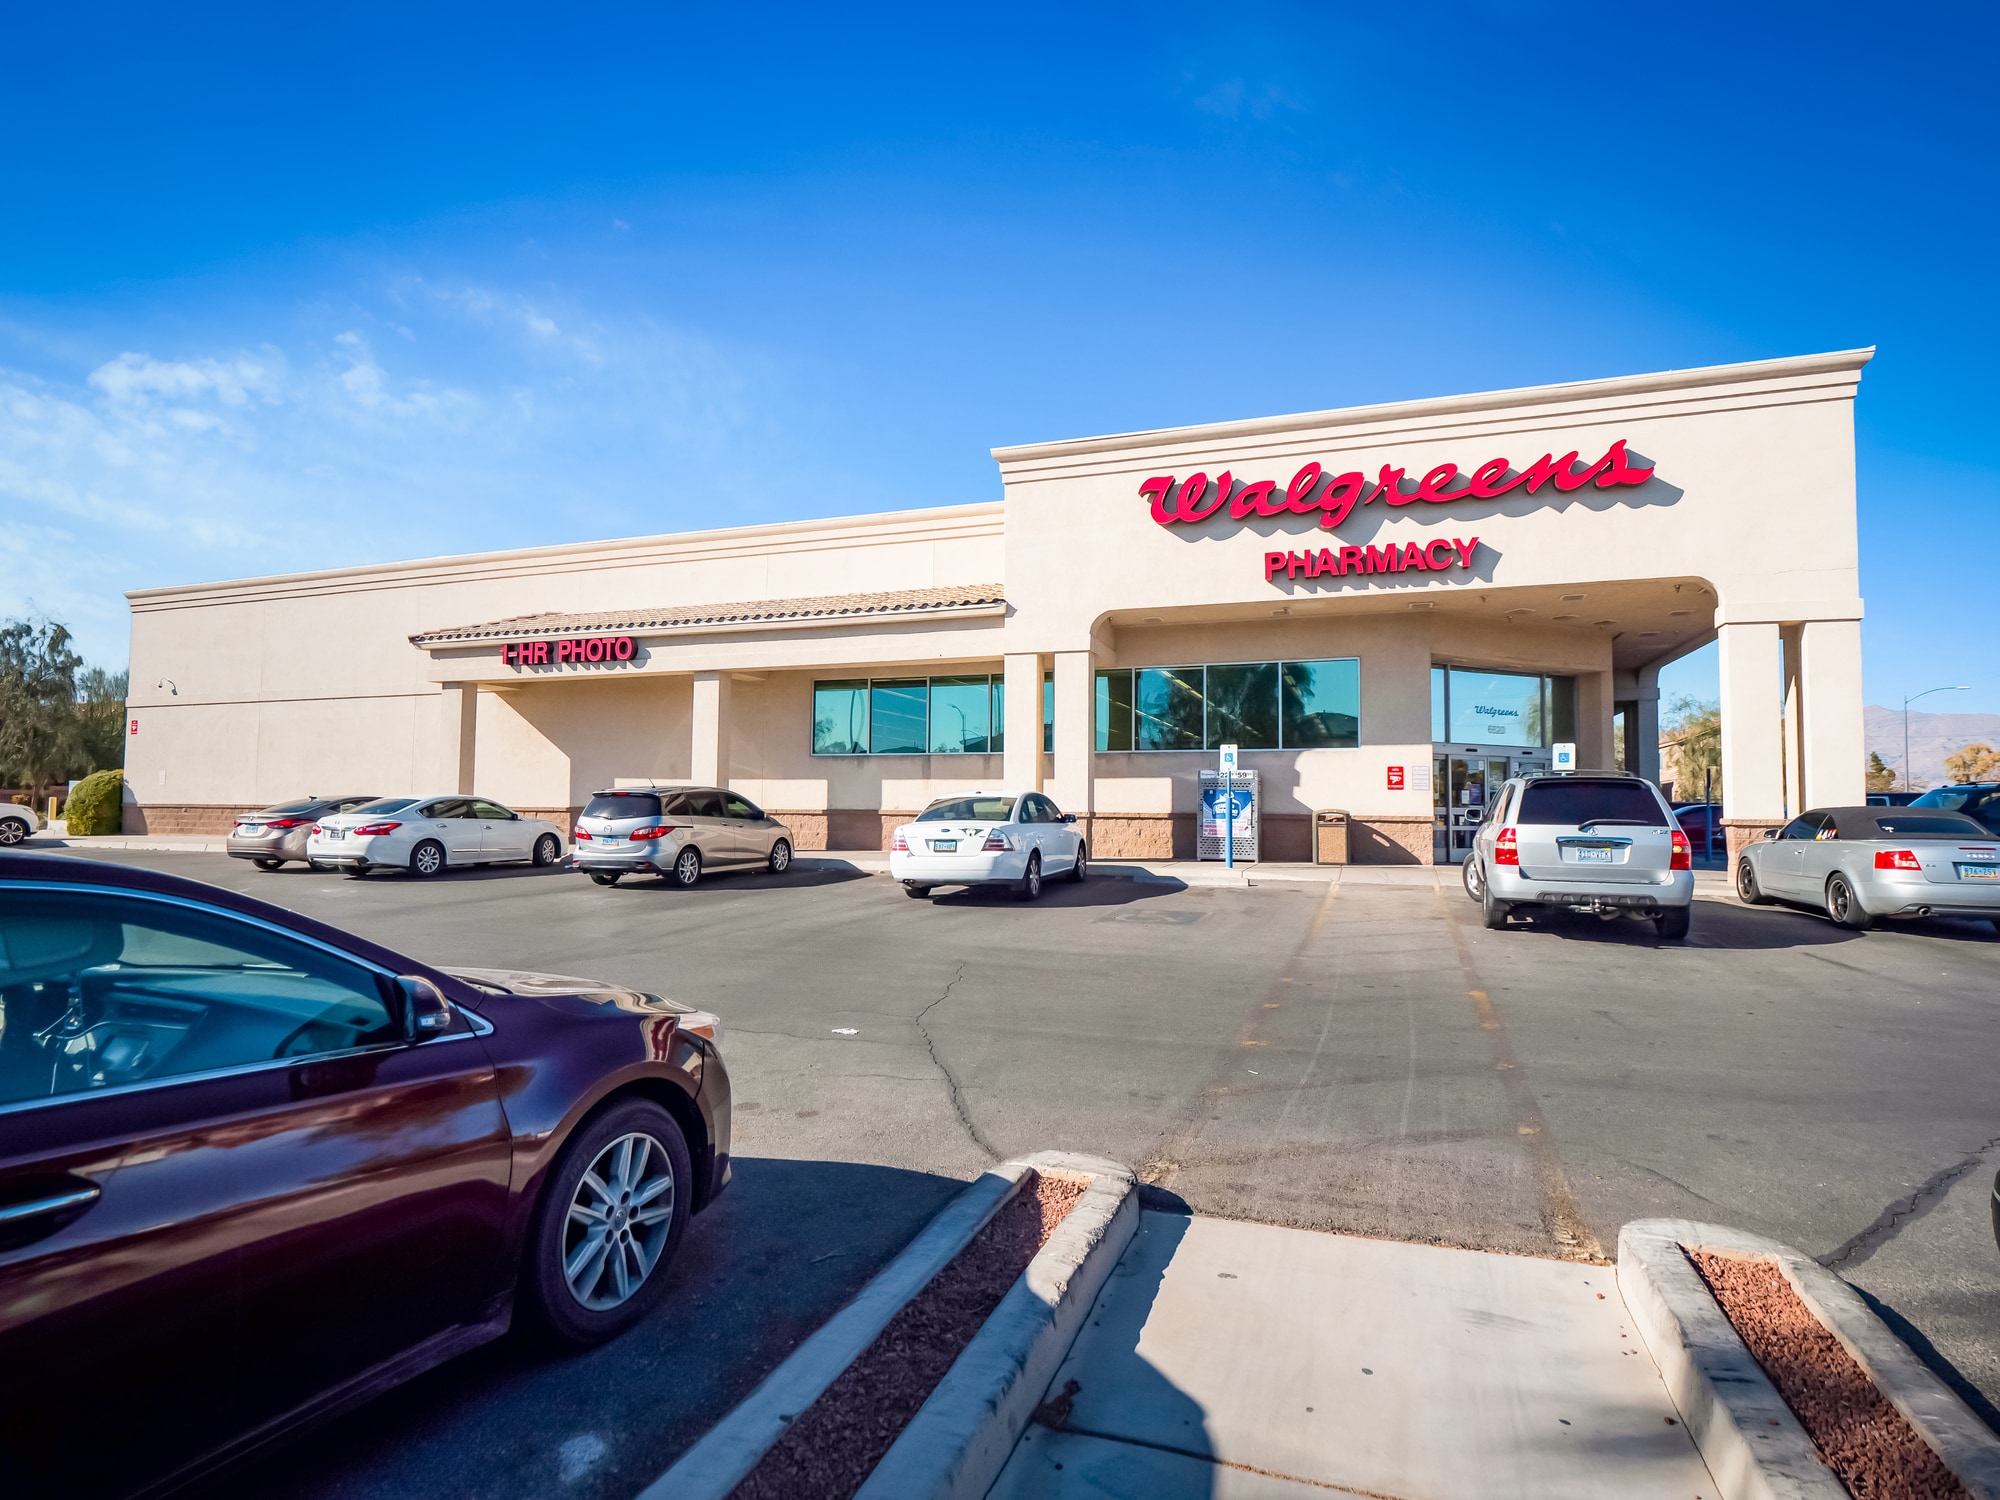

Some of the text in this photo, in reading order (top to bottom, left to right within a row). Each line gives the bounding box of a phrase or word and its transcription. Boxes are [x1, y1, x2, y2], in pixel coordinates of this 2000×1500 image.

[1138, 438, 1655, 529] Walgreens
[1264, 536, 1480, 582] PHARMACY
[499, 636, 636, 666] 1-HR PHOTO
[1474, 705, 1519, 718] Walgreens
